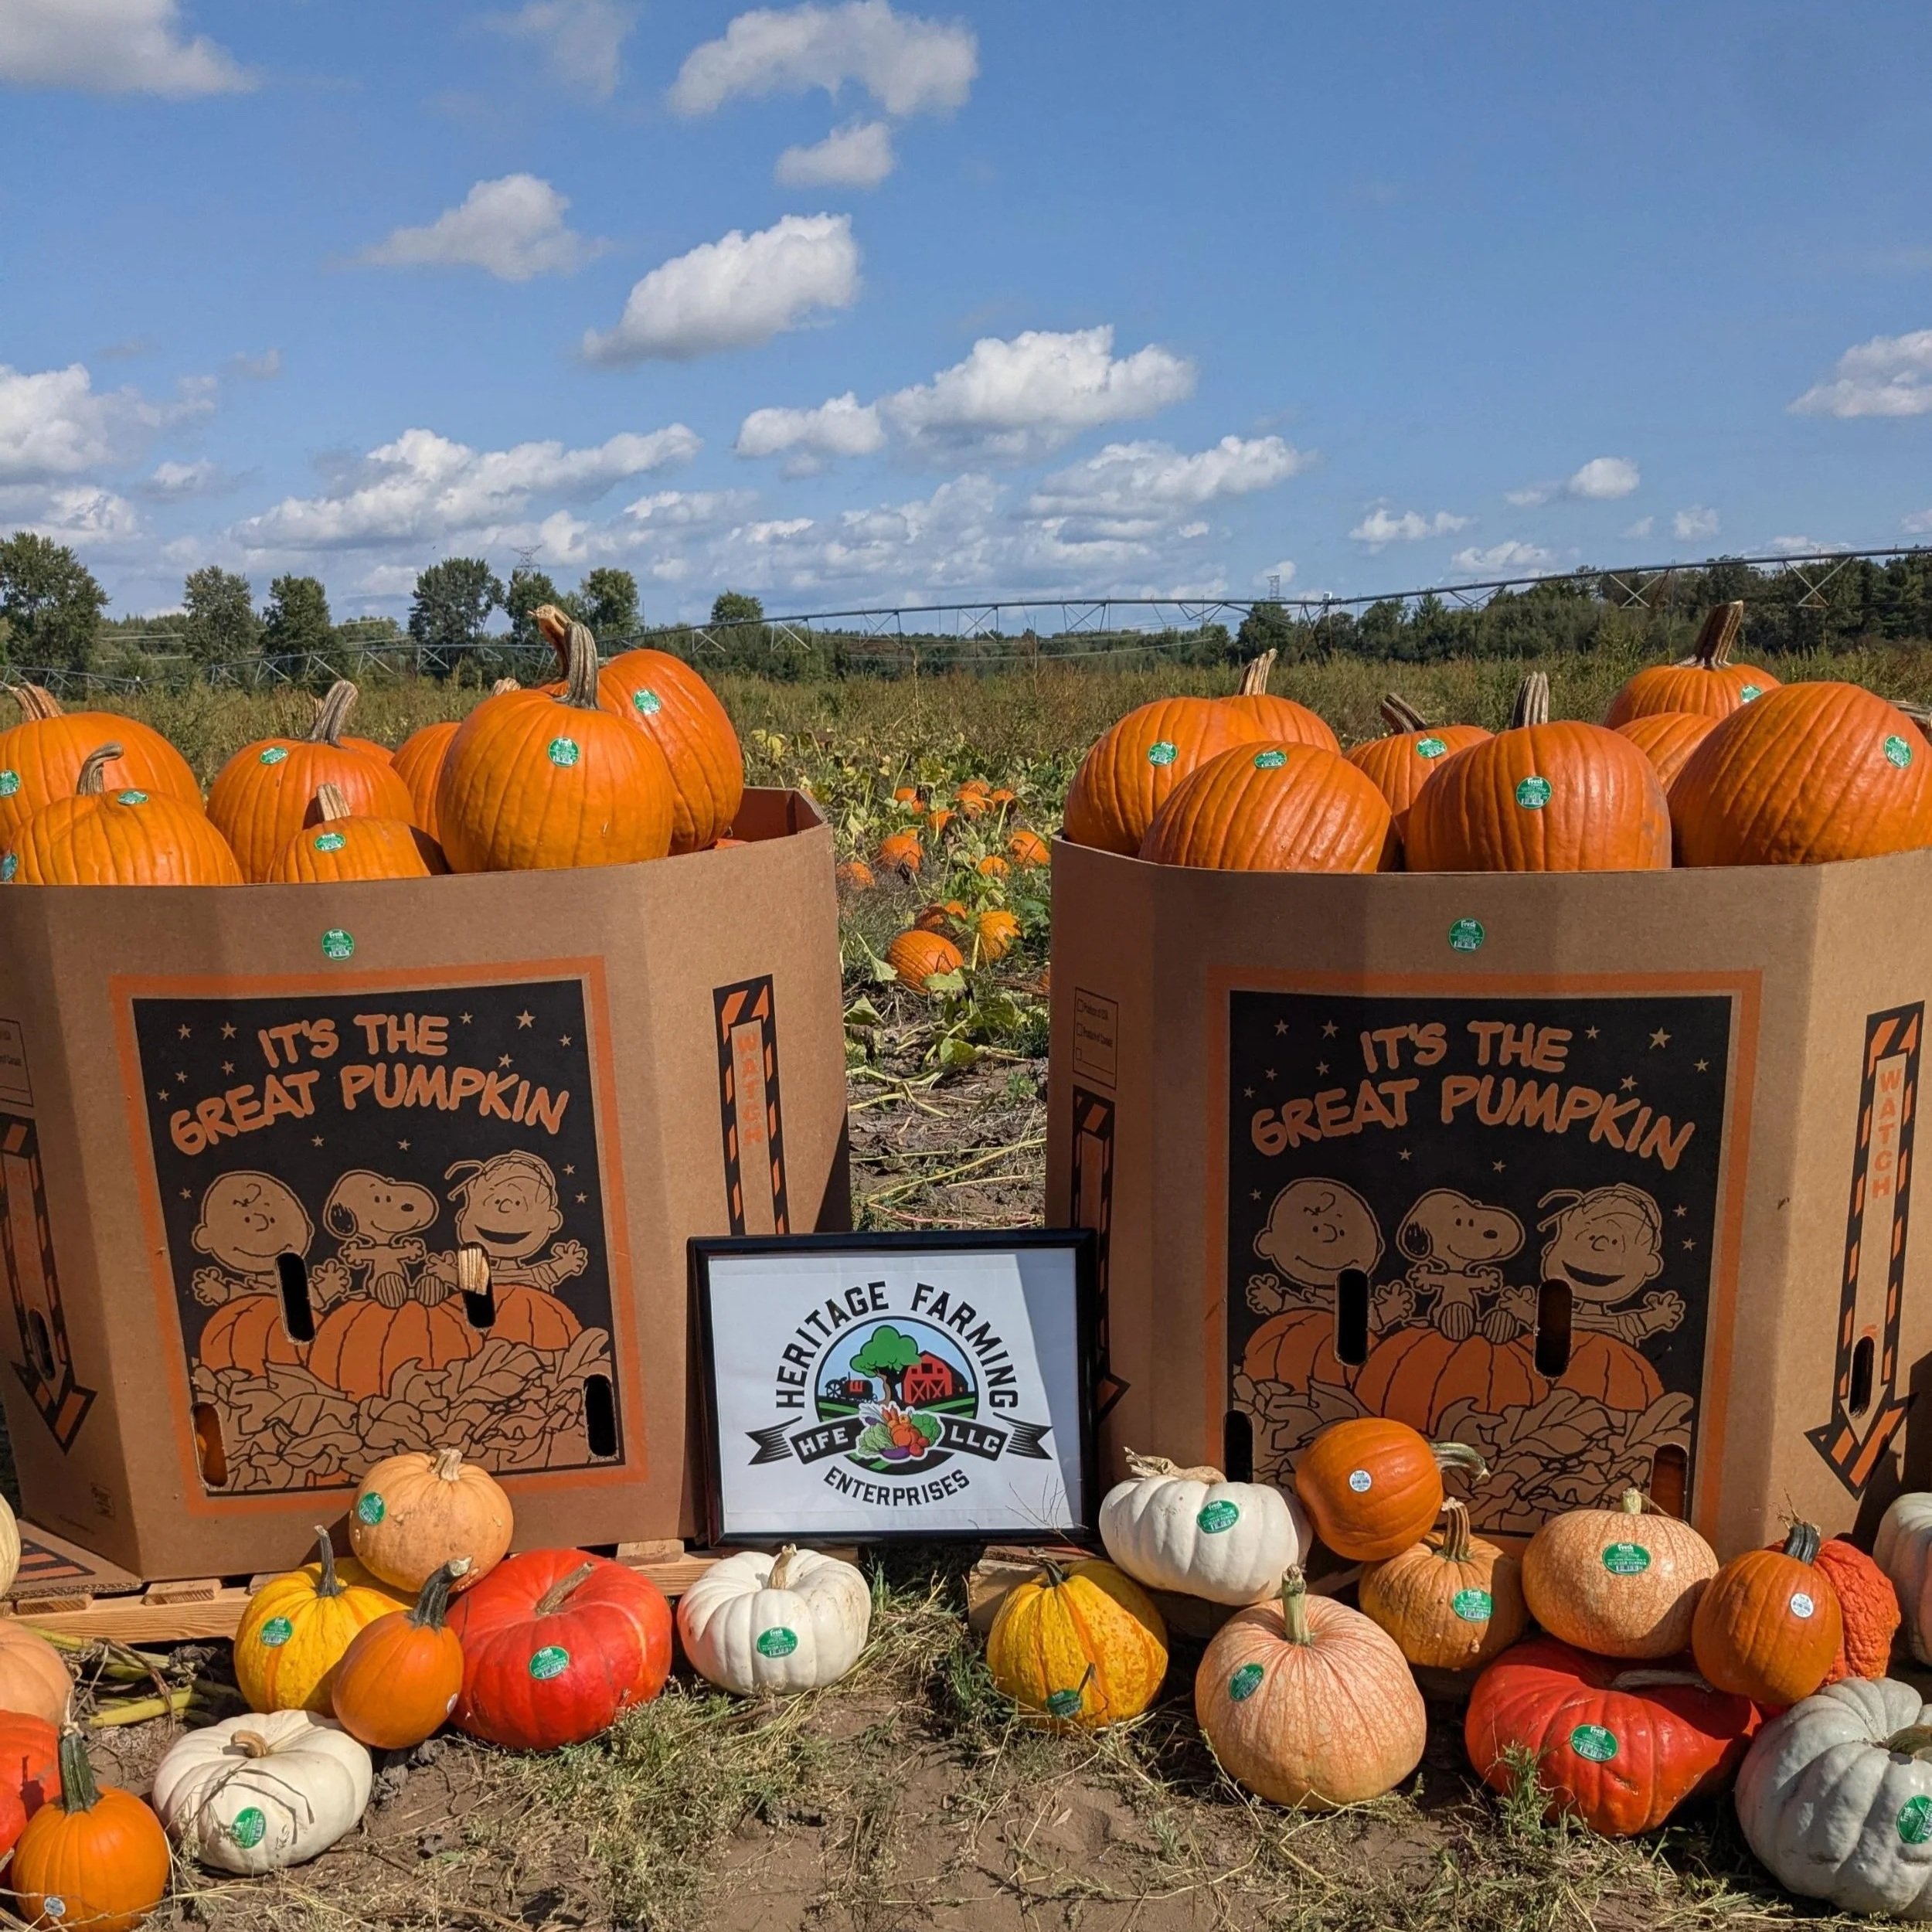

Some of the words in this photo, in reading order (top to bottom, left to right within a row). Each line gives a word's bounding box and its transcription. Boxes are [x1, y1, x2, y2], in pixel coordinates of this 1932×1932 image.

[257, 1018, 339, 1068] IT'S
[353, 1012, 449, 1056] THE
[1360, 1022, 1446, 1073] IT'S
[1468, 1020, 1572, 1073] THE
[170, 1070, 320, 1155] GREAT
[340, 1062, 569, 1134] PUMPKIN
[736, 1032, 764, 1145] WATCH
[1250, 1079, 1419, 1156] GREAT
[1440, 1074, 1695, 1170] PUMPKIN
[1872, 1067, 1903, 1198] WATCH
[775, 1281, 889, 1409] HERITAGE
[910, 1282, 1019, 1408] FARMING
[798, 1426, 849, 1457] HFE
[950, 1426, 1001, 1452] LLC
[823, 1465, 971, 1507] ENTERPRISES
